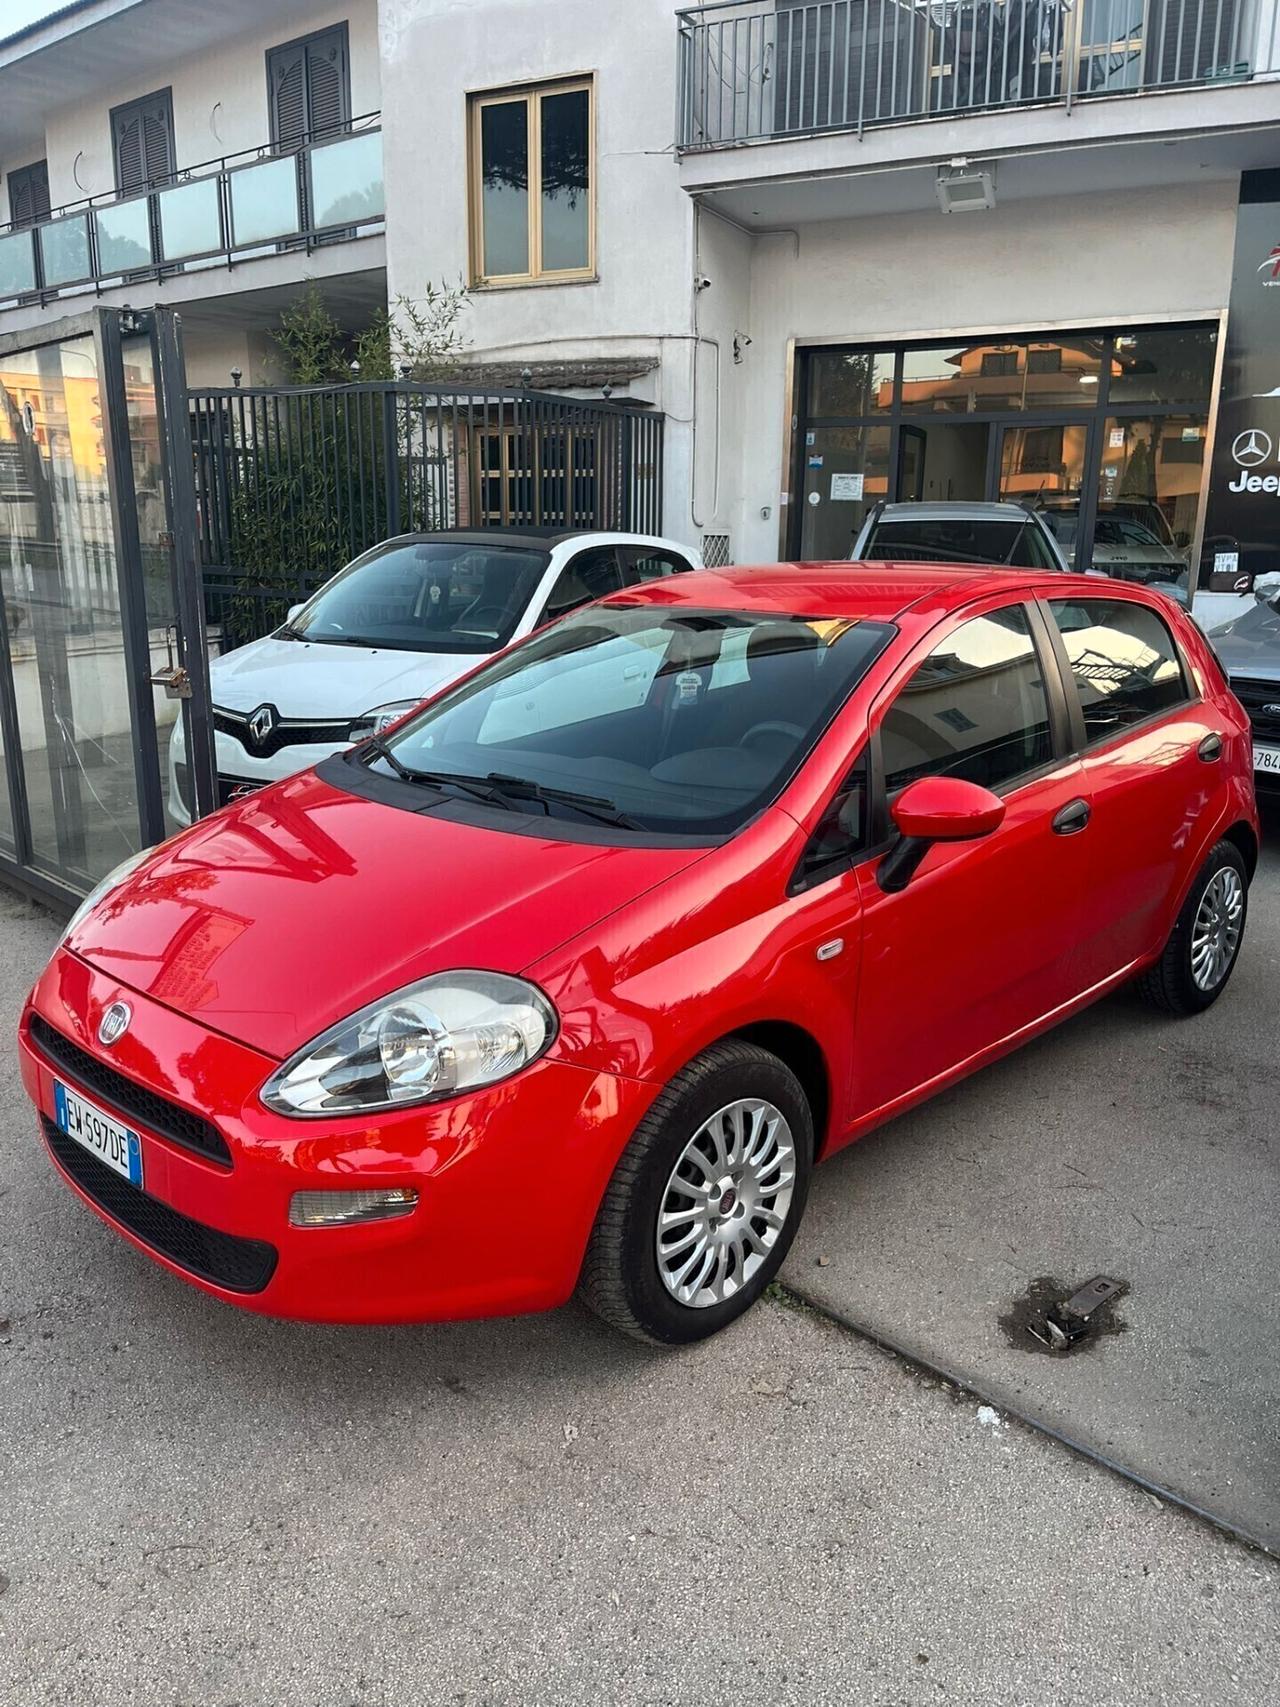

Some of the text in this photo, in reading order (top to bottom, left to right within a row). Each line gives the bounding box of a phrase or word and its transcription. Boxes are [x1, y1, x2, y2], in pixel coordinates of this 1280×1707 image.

[1228, 470, 1280, 497] Jee
[1257, 752, 1280, 769] 784
[104, 1012, 123, 1035] FIAT
